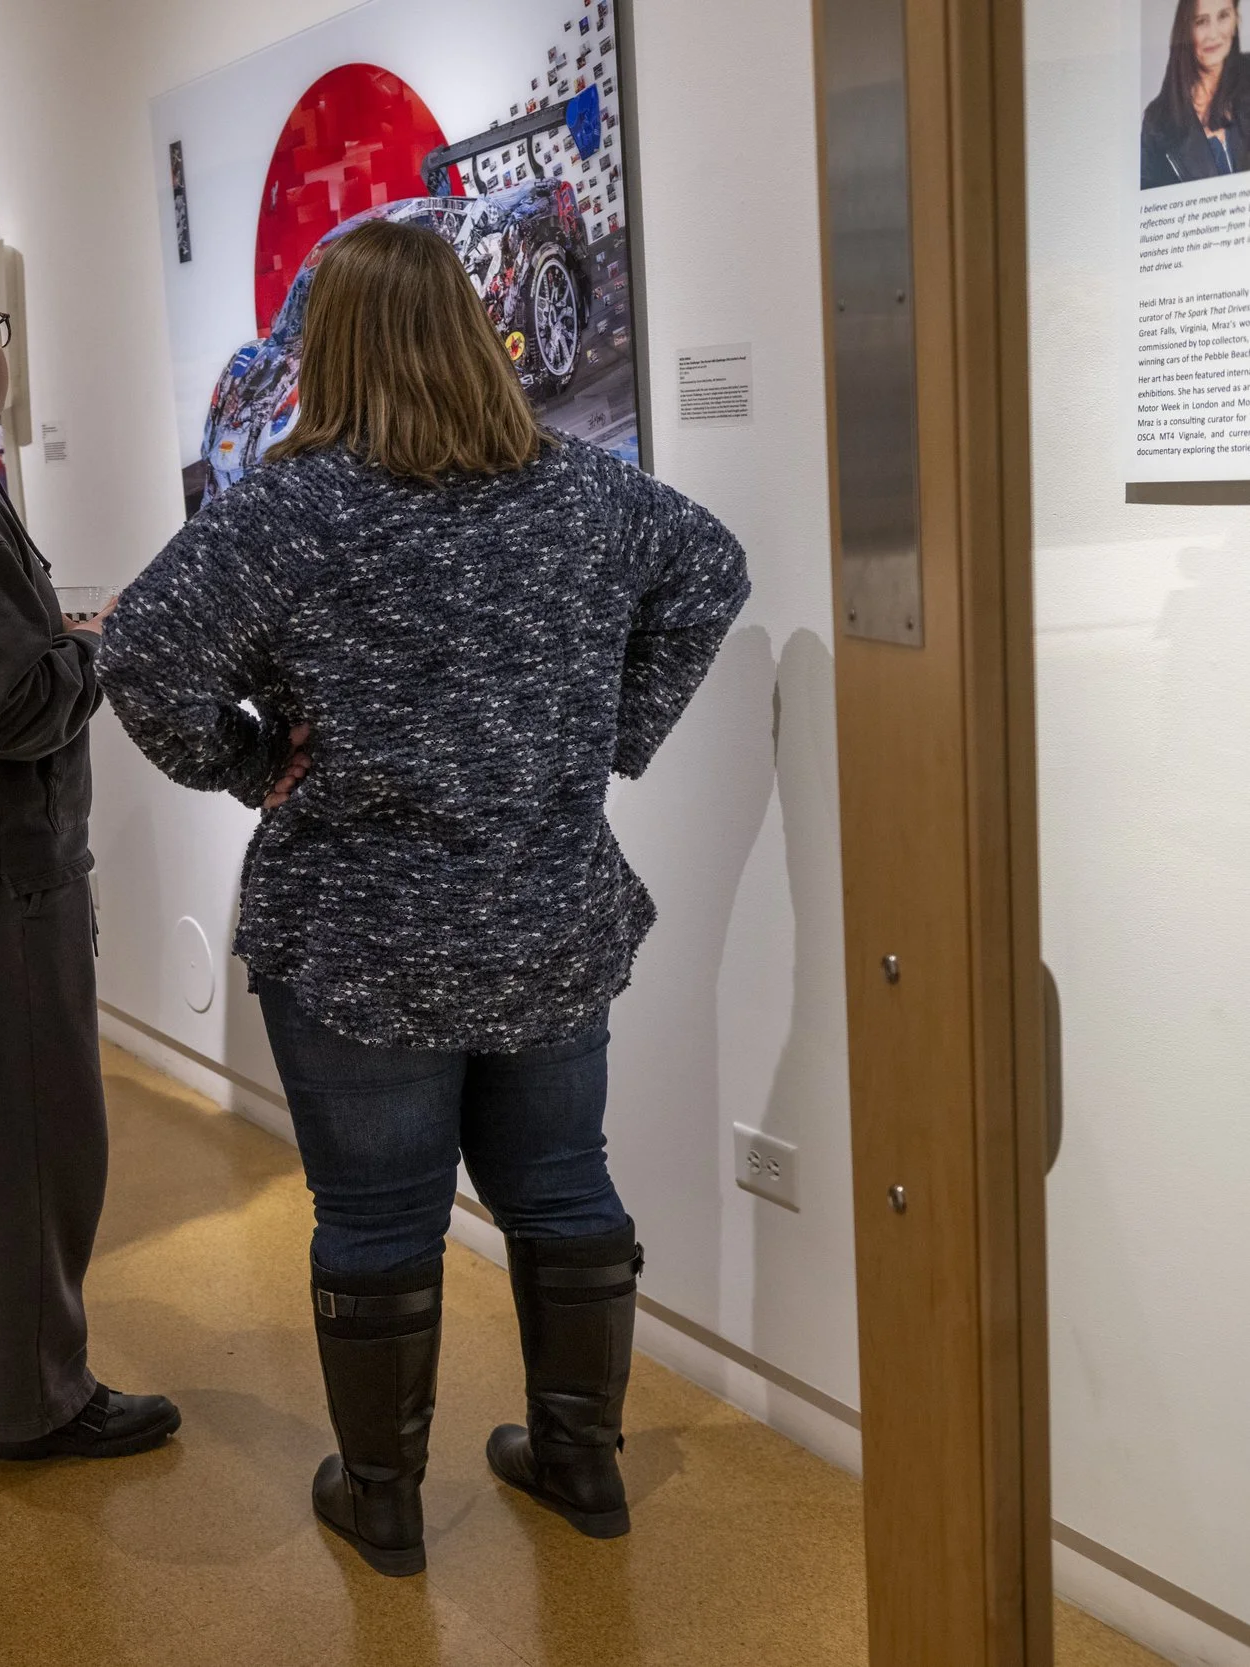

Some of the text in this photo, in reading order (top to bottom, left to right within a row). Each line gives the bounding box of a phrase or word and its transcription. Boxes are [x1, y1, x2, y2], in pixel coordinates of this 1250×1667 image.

[1143, 203, 1168, 214] believe
[1168, 201, 1184, 209] cars
[1185, 198, 1198, 207] are
[1198, 195, 1218, 204] more
[1219, 192, 1237, 201] than
[1139, 217, 1175, 230] reflections
[1177, 214, 1186, 224] of
[1187, 213, 1200, 222] the
[1201, 208, 1227, 220] people
[1229, 206, 1246, 215] who
[1139, 234, 1164, 243] illusion
[1165, 230, 1180, 240] and
[1139, 247, 1169, 258] vanishes
[1170, 245, 1185, 254] into
[1186, 243, 1201, 252] thin
[1233, 236, 1245, 245] art
[1139, 261, 1184, 273] that drive us.
[1139, 288, 1249, 308] Heidi Mraz is an internationally
[1138, 314, 1164, 323] curator
[1164, 311, 1172, 320] of
[1174, 310, 1187, 319] The
[1187, 307, 1208, 319] Spark
[1210, 306, 1226, 315] That
[1138, 328, 1158, 338] Great
[1160, 326, 1177, 335] Falls,
[1179, 323, 1208, 334] Virginia,
[1138, 336, 1249, 352] commissioned by top collectors,
[1138, 357, 1165, 367] winning
[1166, 356, 1181, 365] cars
[1181, 353, 1190, 363] of
[1190, 353, 1203, 362] the
[1204, 351, 1229, 361] Pebble
[1138, 376, 1151, 384] Her
[1151, 375, 1162, 383] art
[1162, 373, 1175, 382] has
[1175, 372, 1194, 381] been
[1194, 369, 1226, 380] featured
[1137, 388, 1176, 399] exhibitions.
[1177, 387, 1191, 396] She
[1192, 386, 1205, 395] has
[1206, 383, 1231, 394] served
[1232, 384, 1241, 392] as
[1137, 404, 1159, 413] Motor
[1160, 402, 1181, 411] Week
[1182, 401, 1190, 410] in
[1191, 400, 1219, 410] London
[1220, 398, 1235, 408] and
[1137, 419, 1154, 427] Mraz
[1155, 418, 1162, 426] is
[1169, 415, 1206, 426] consulting
[1207, 415, 1234, 424] curator
[1236, 413, 1246, 422] for
[1136, 432, 1156, 442] OSCA
[1159, 431, 1175, 440] MT4
[1178, 430, 1207, 441] Vignale,
[1210, 429, 1225, 438] and
[1136, 447, 1182, 456] documentary
[1182, 445, 1216, 455] exploring
[1216, 444, 1230, 453] the
